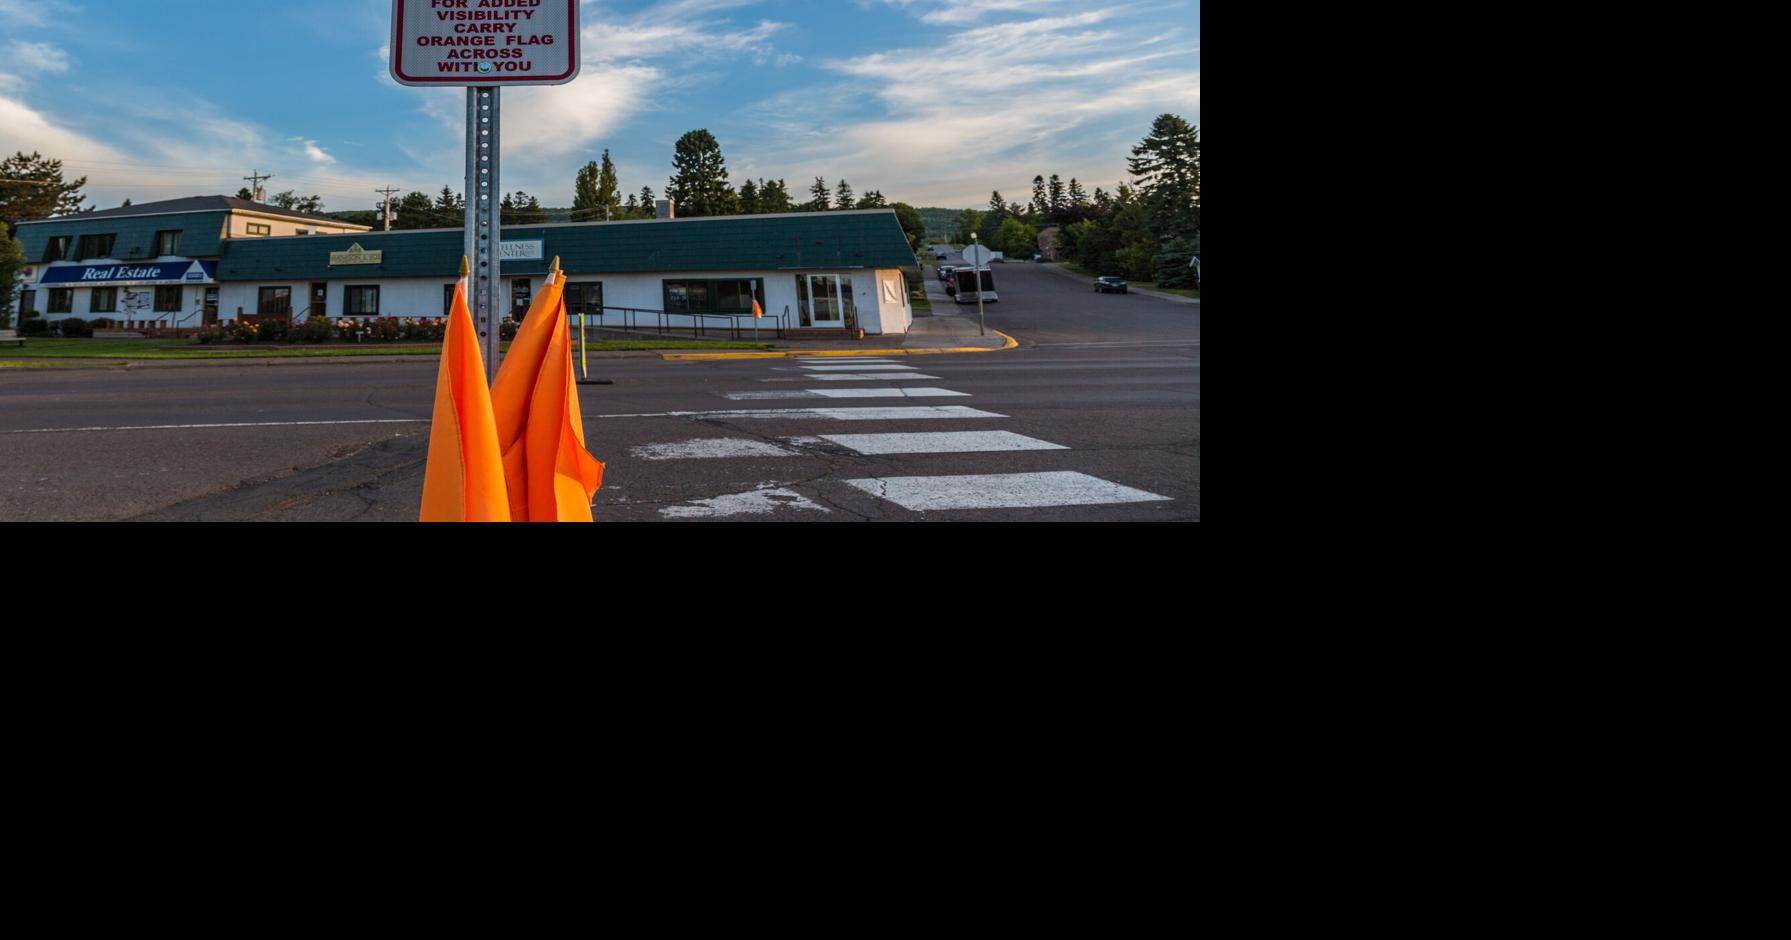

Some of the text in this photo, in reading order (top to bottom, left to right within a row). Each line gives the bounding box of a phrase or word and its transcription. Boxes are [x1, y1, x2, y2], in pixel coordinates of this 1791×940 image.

[431, 0, 541, 8] FOR ADDED
[436, 10, 535, 21] VISIBILITY
[454, 23, 517, 33] CARRY
[416, 35, 554, 46] ORANGE FLAG
[447, 48, 523, 59] ACROSS
[493, 61, 532, 72] YOU
[81, 266, 161, 280] Real Estate
